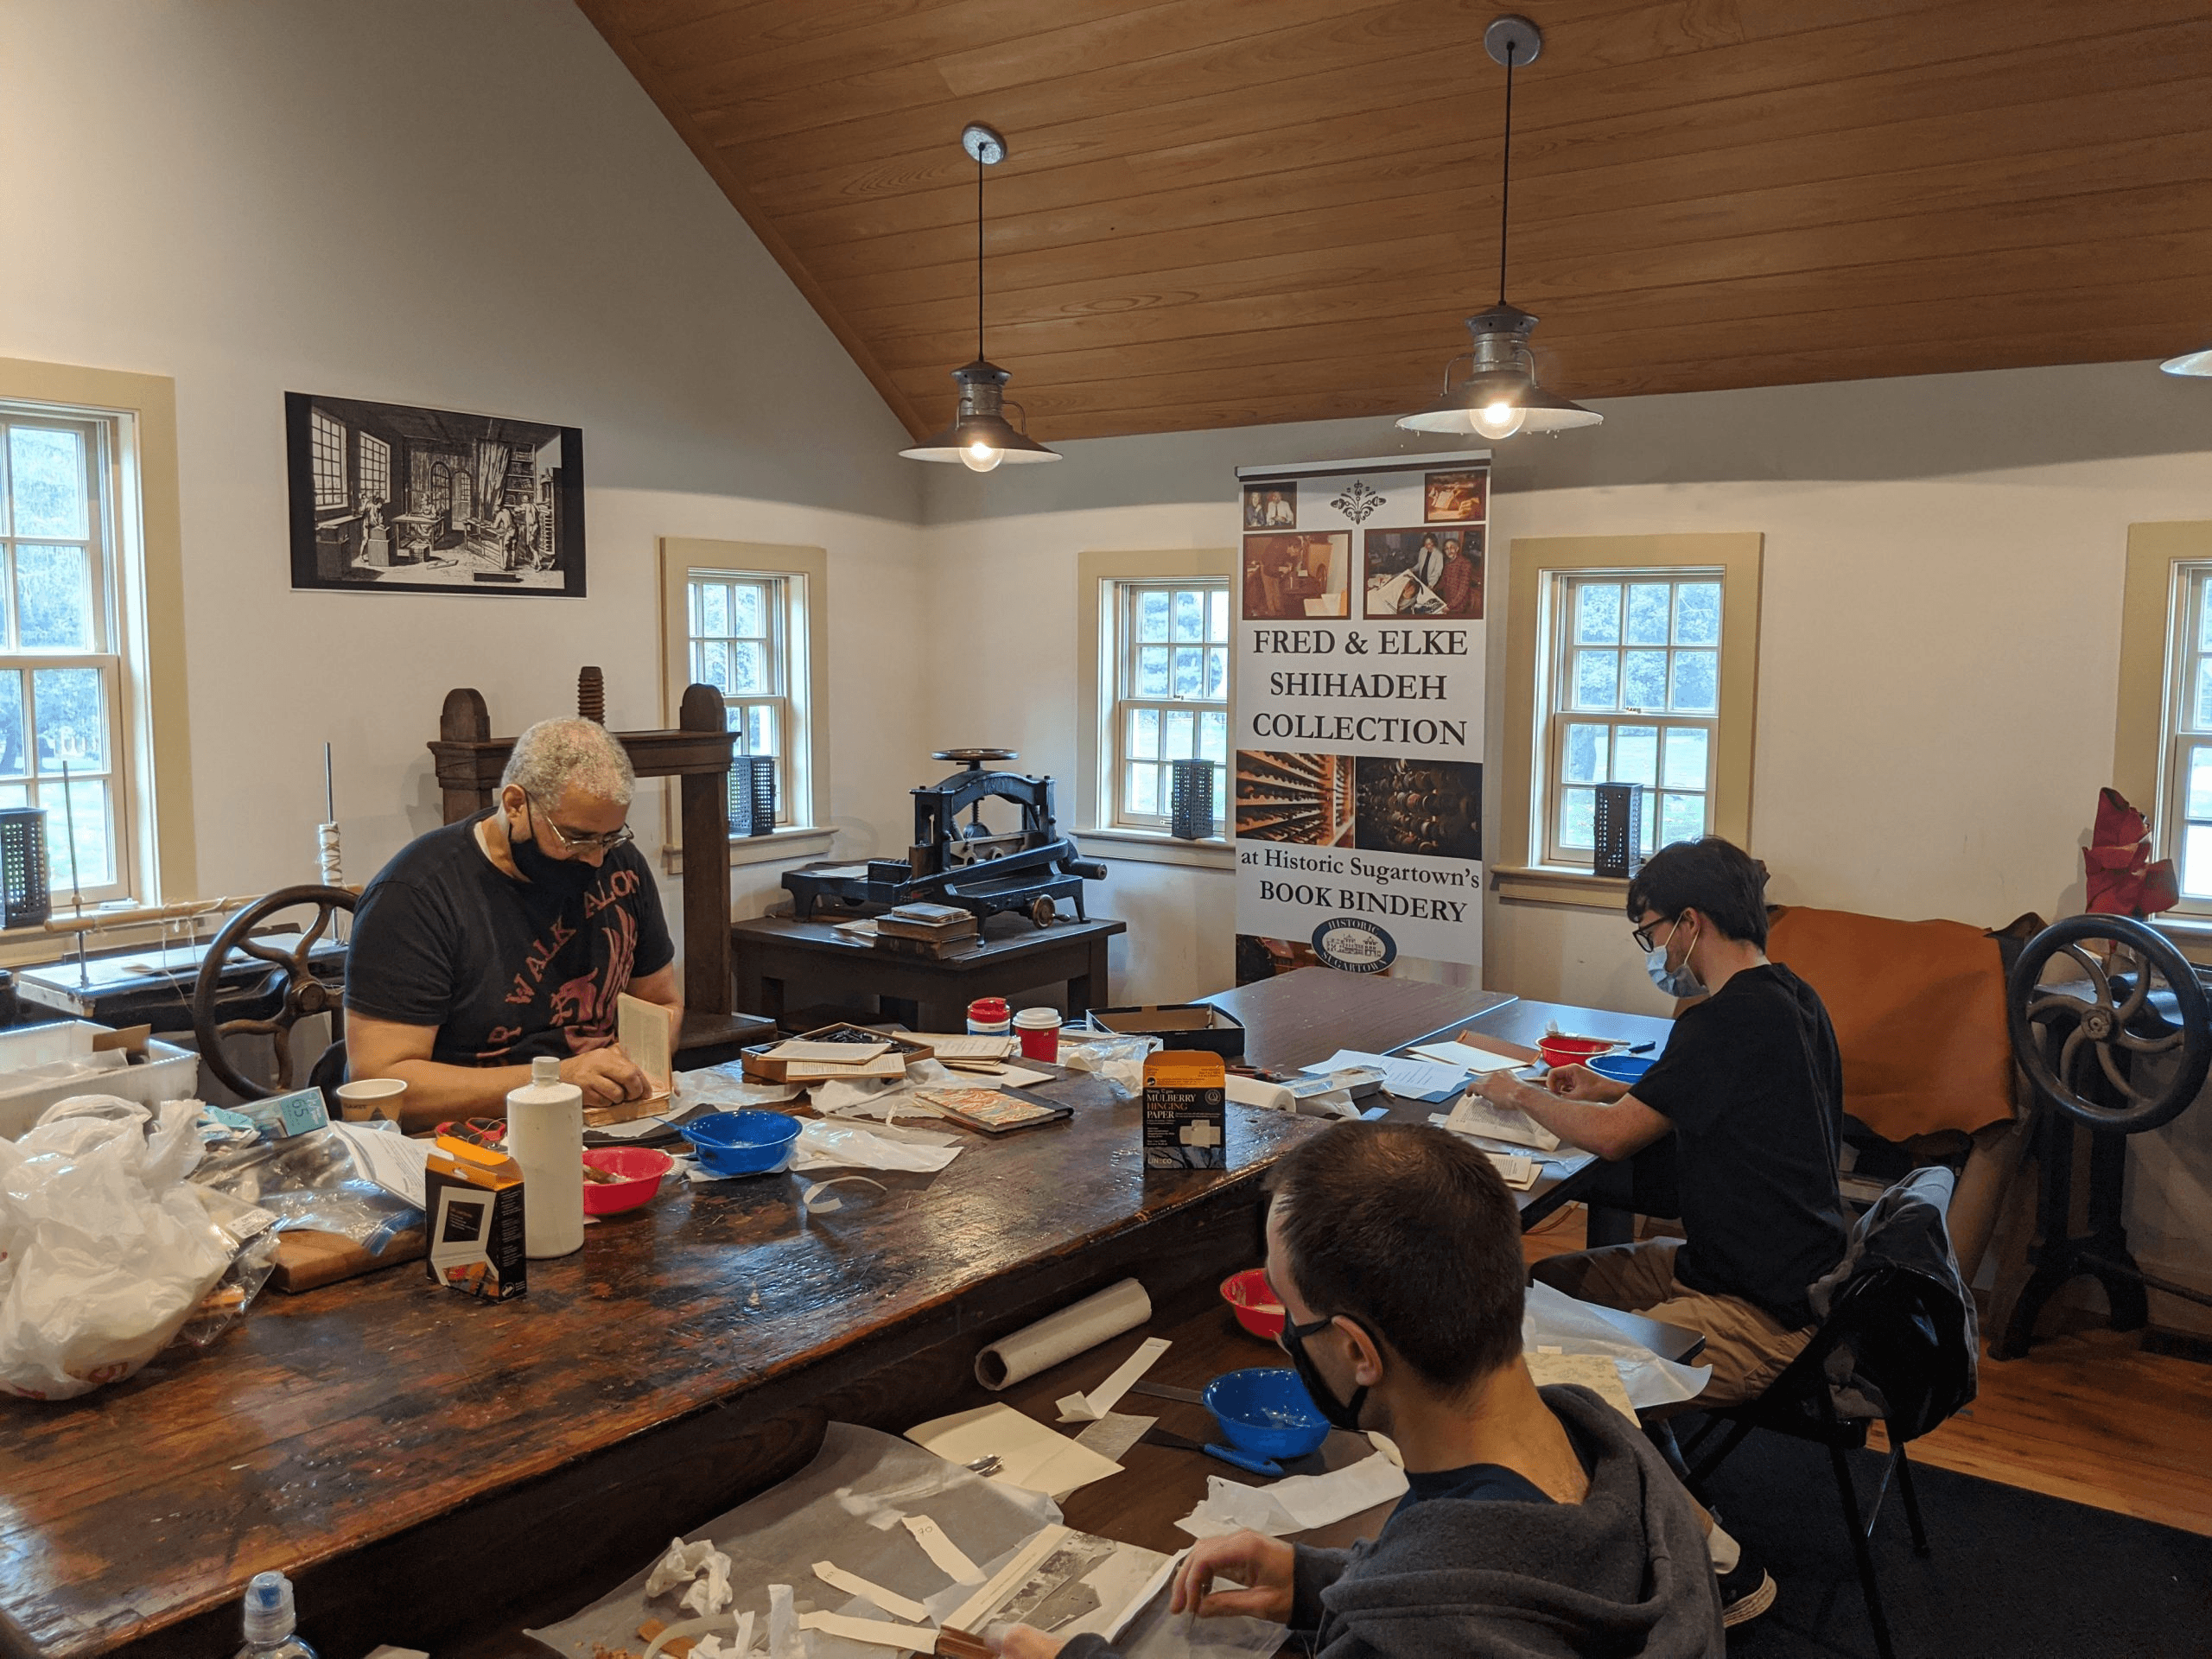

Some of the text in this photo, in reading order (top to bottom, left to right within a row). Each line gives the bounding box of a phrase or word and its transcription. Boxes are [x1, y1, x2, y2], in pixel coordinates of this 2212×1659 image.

[1253, 630, 1468, 656] FRED & ELKE
[1270, 671, 1448, 701] SHIHADEH
[1252, 713, 1468, 746] COLLECTION
[1241, 849, 1480, 889] at Historic Sugartown's
[1259, 880, 1468, 923] BOOK BINDERY
[1328, 918, 1380, 936] HISTORIC
[505, 916, 576, 1004] WALK
[1322, 951, 1388, 973] SUGARTOWN
[1147, 1094, 1196, 1103] MULBERRY
[1147, 1110, 1175, 1119] PAPER
